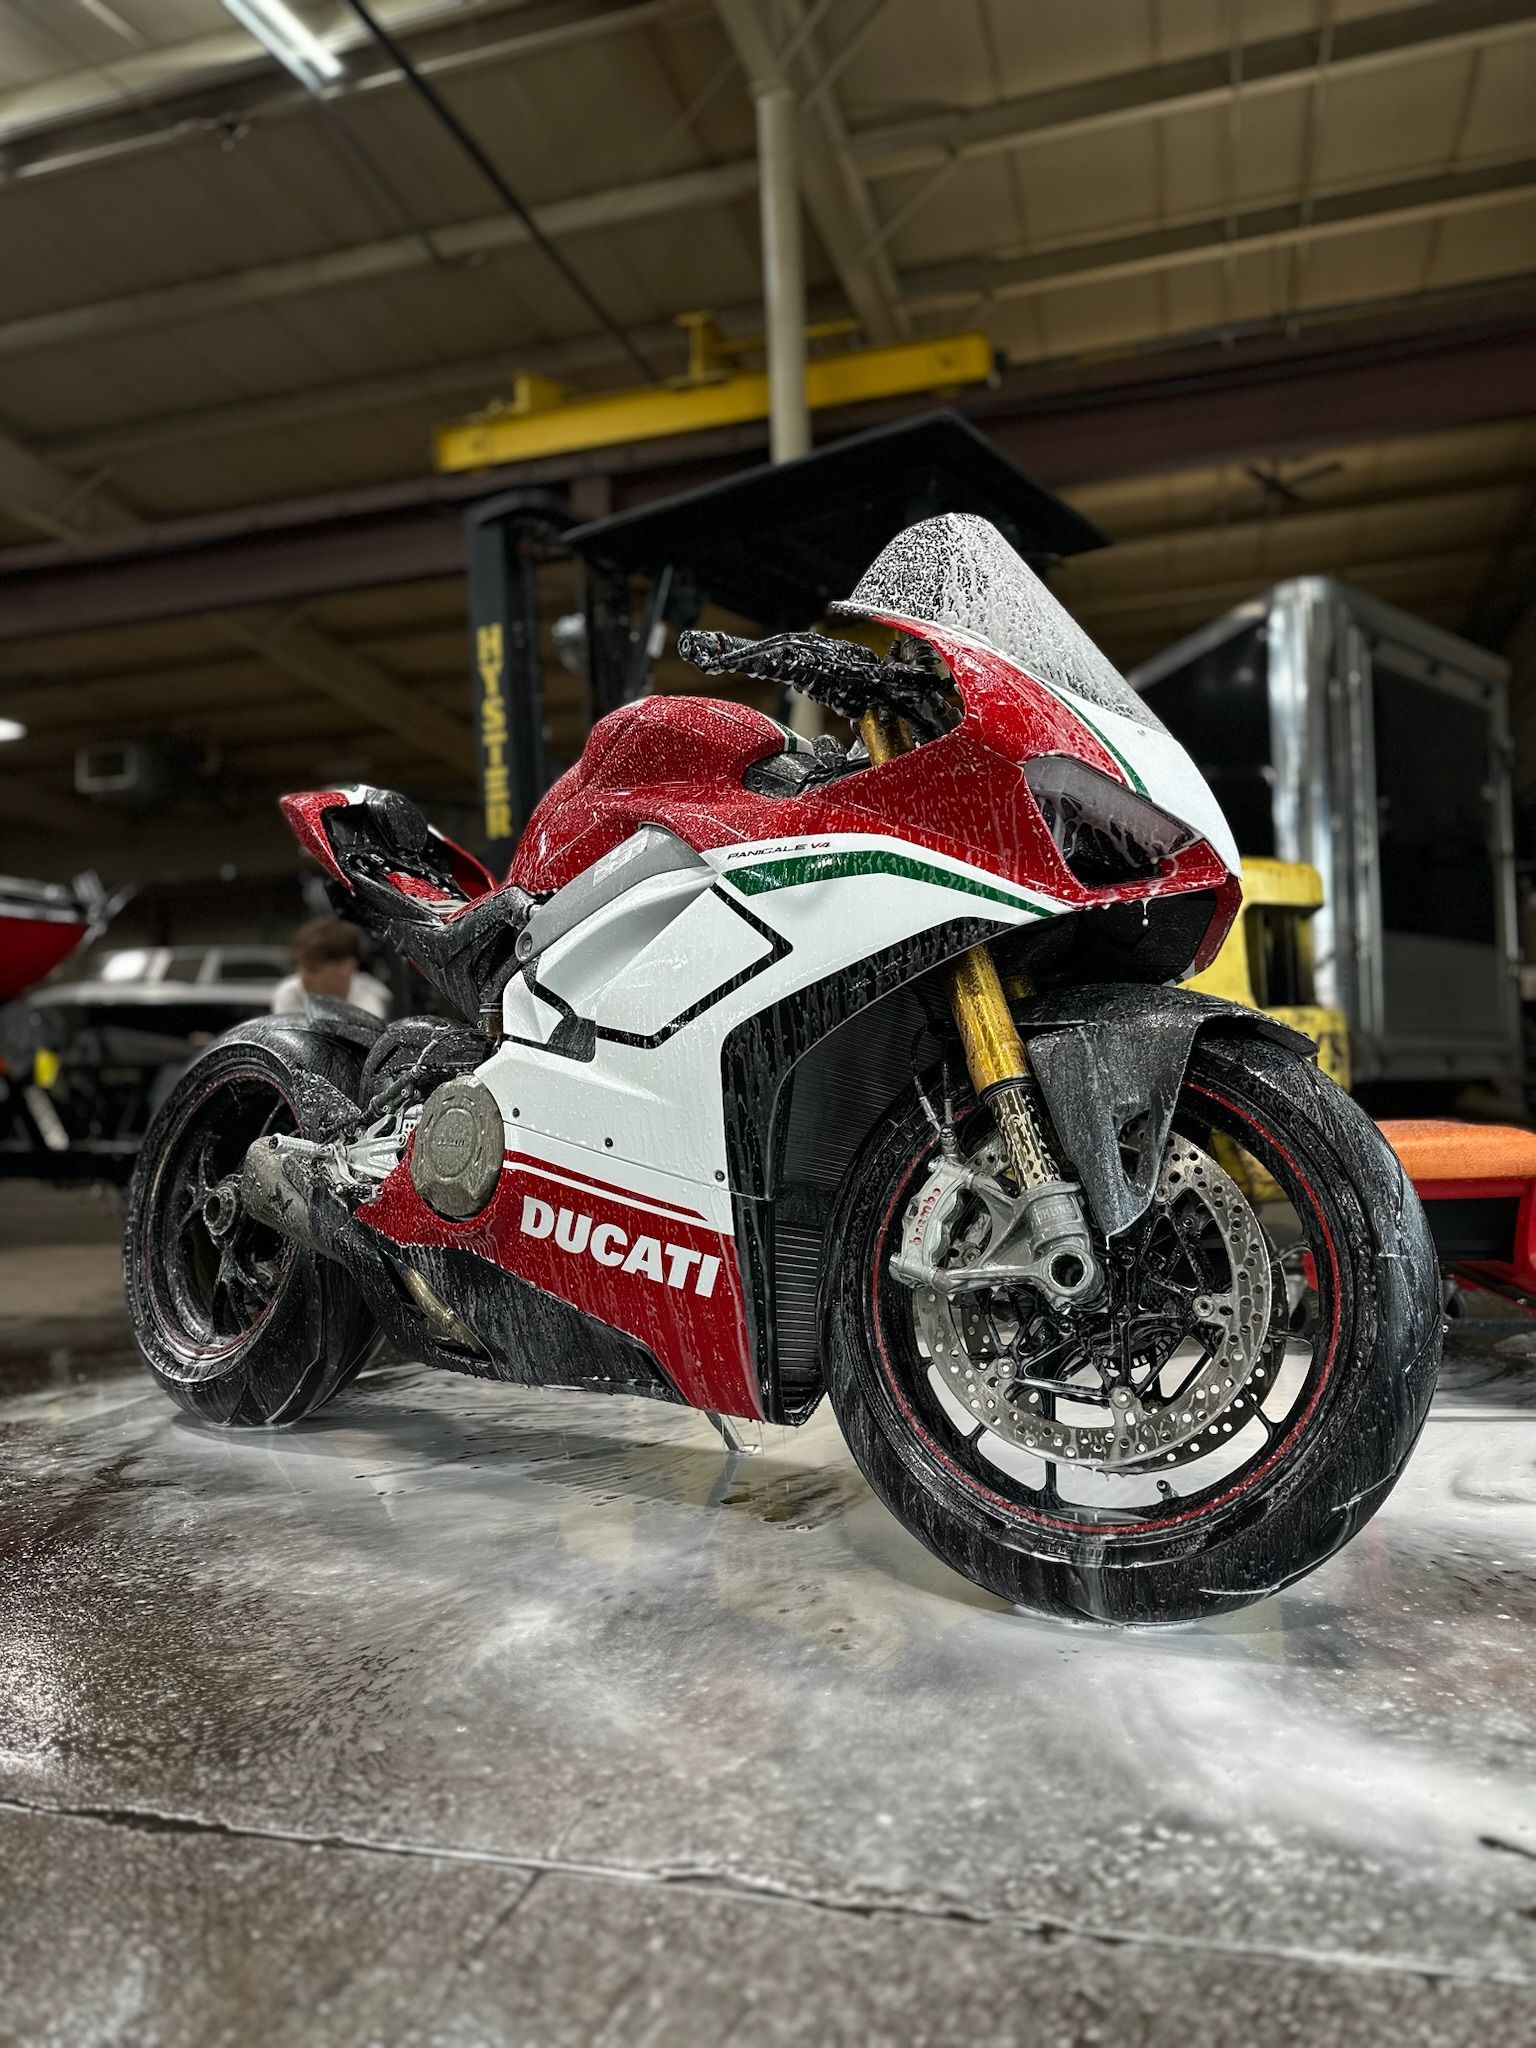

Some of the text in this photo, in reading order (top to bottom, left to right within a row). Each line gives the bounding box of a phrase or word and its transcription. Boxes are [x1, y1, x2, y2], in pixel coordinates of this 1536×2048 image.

[476, 622, 512, 839] HYSTER
[727, 843, 808, 860] PANIGALE
[520, 1195, 722, 1298] DUCATI
[909, 1187, 941, 1246] brembo
